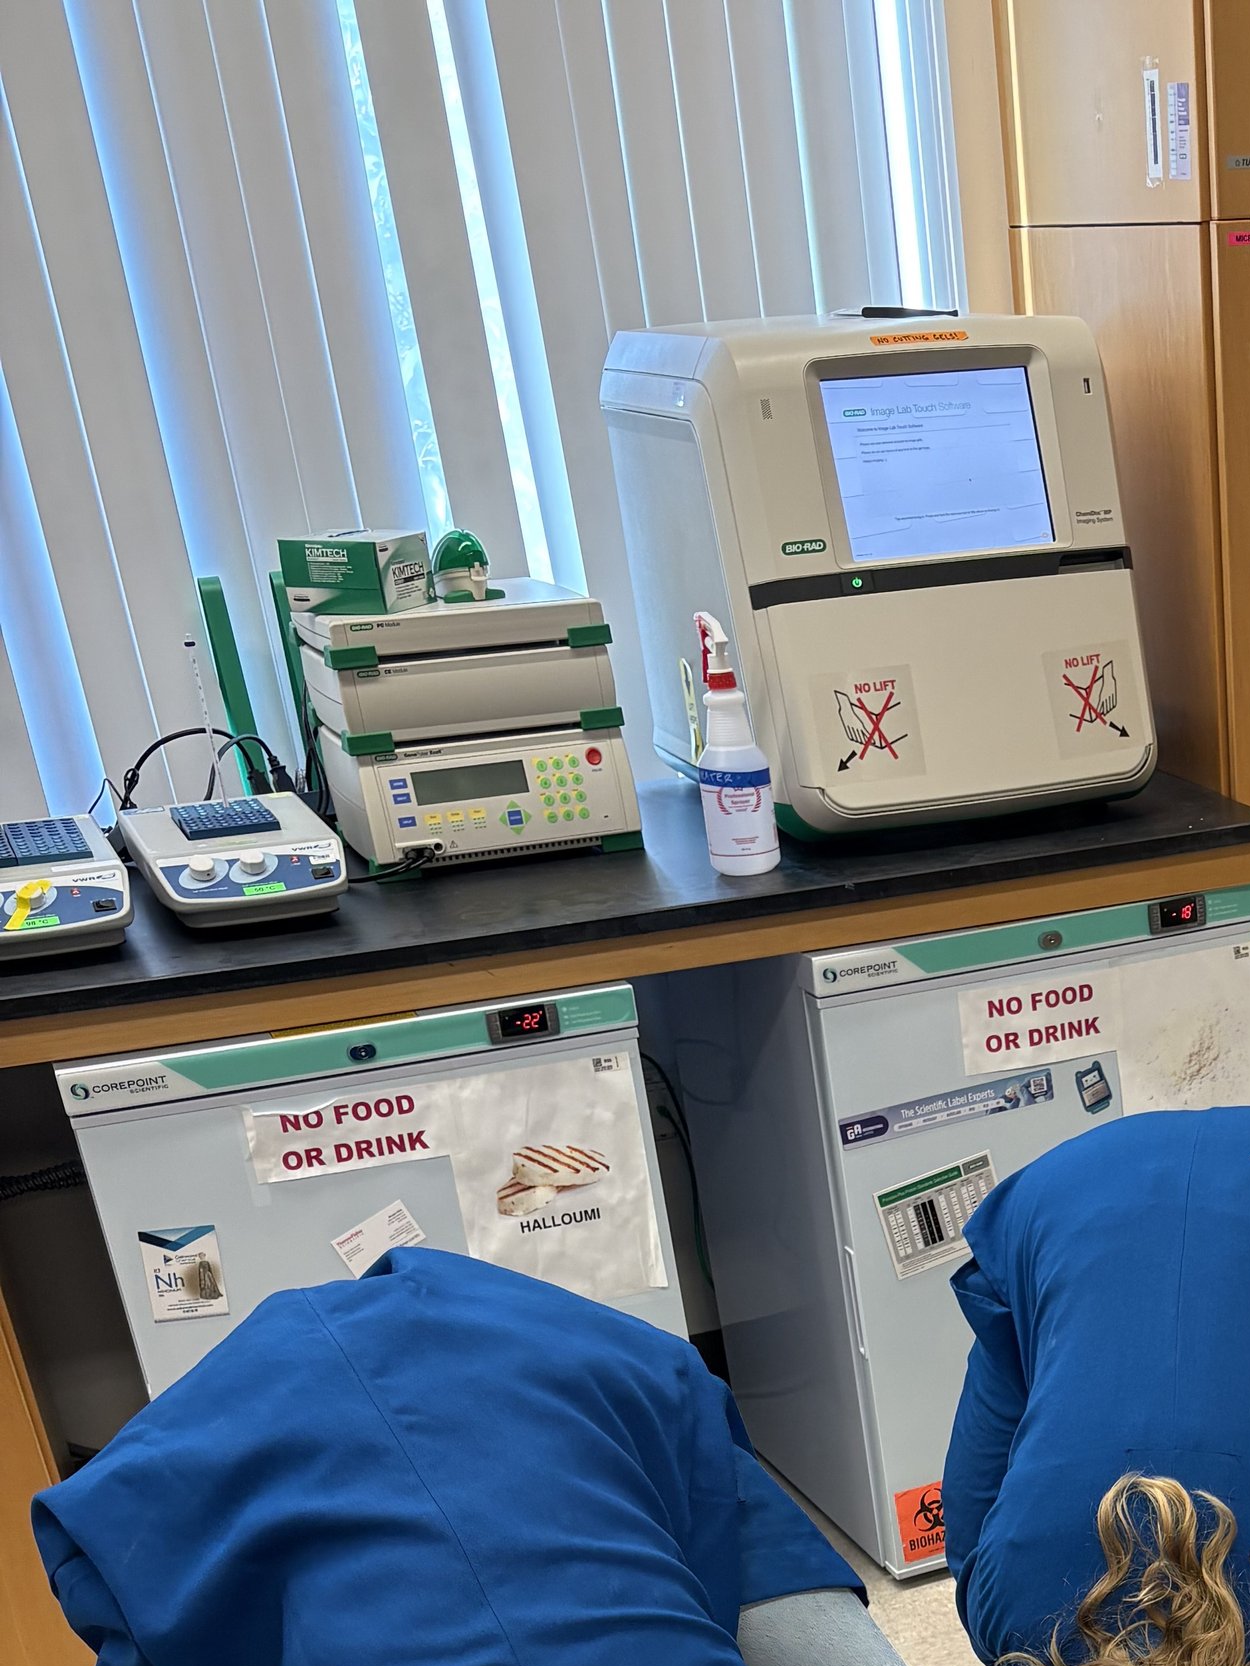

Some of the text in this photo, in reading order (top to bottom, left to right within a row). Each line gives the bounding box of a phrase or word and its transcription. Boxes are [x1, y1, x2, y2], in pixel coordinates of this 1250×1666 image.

[893, 334, 929, 343] CUTTING
[870, 406, 895, 420] Image
[896, 404, 912, 414] Lab
[913, 402, 937, 413] Touch
[938, 400, 971, 410] Software
[305, 548, 347, 558] KIMTECH
[391, 561, 424, 579] KIMTECH
[1064, 653, 1101, 669] NO LIFT
[854, 679, 897, 694] NO LIFT
[839, 960, 898, 977] COREPOINT
[867, 968, 898, 978] SCIENTIFIC
[987, 983, 1094, 1018] NO FOOD
[985, 1016, 1101, 1053] OR DRINK
[92, 1075, 167, 1093] COREPOINT
[129, 1084, 169, 1094] SCIENTIFIC
[900, 1107, 915, 1119] The
[915, 1099, 948, 1116] Scientific
[948, 1093, 968, 1108] Label
[968, 1088, 996, 1103] Experts
[279, 1094, 415, 1133] NO FOOD
[282, 1129, 430, 1171] OR DRINK
[520, 1207, 601, 1234] HALLOUMI
[154, 1272, 185, 1290] Nh
